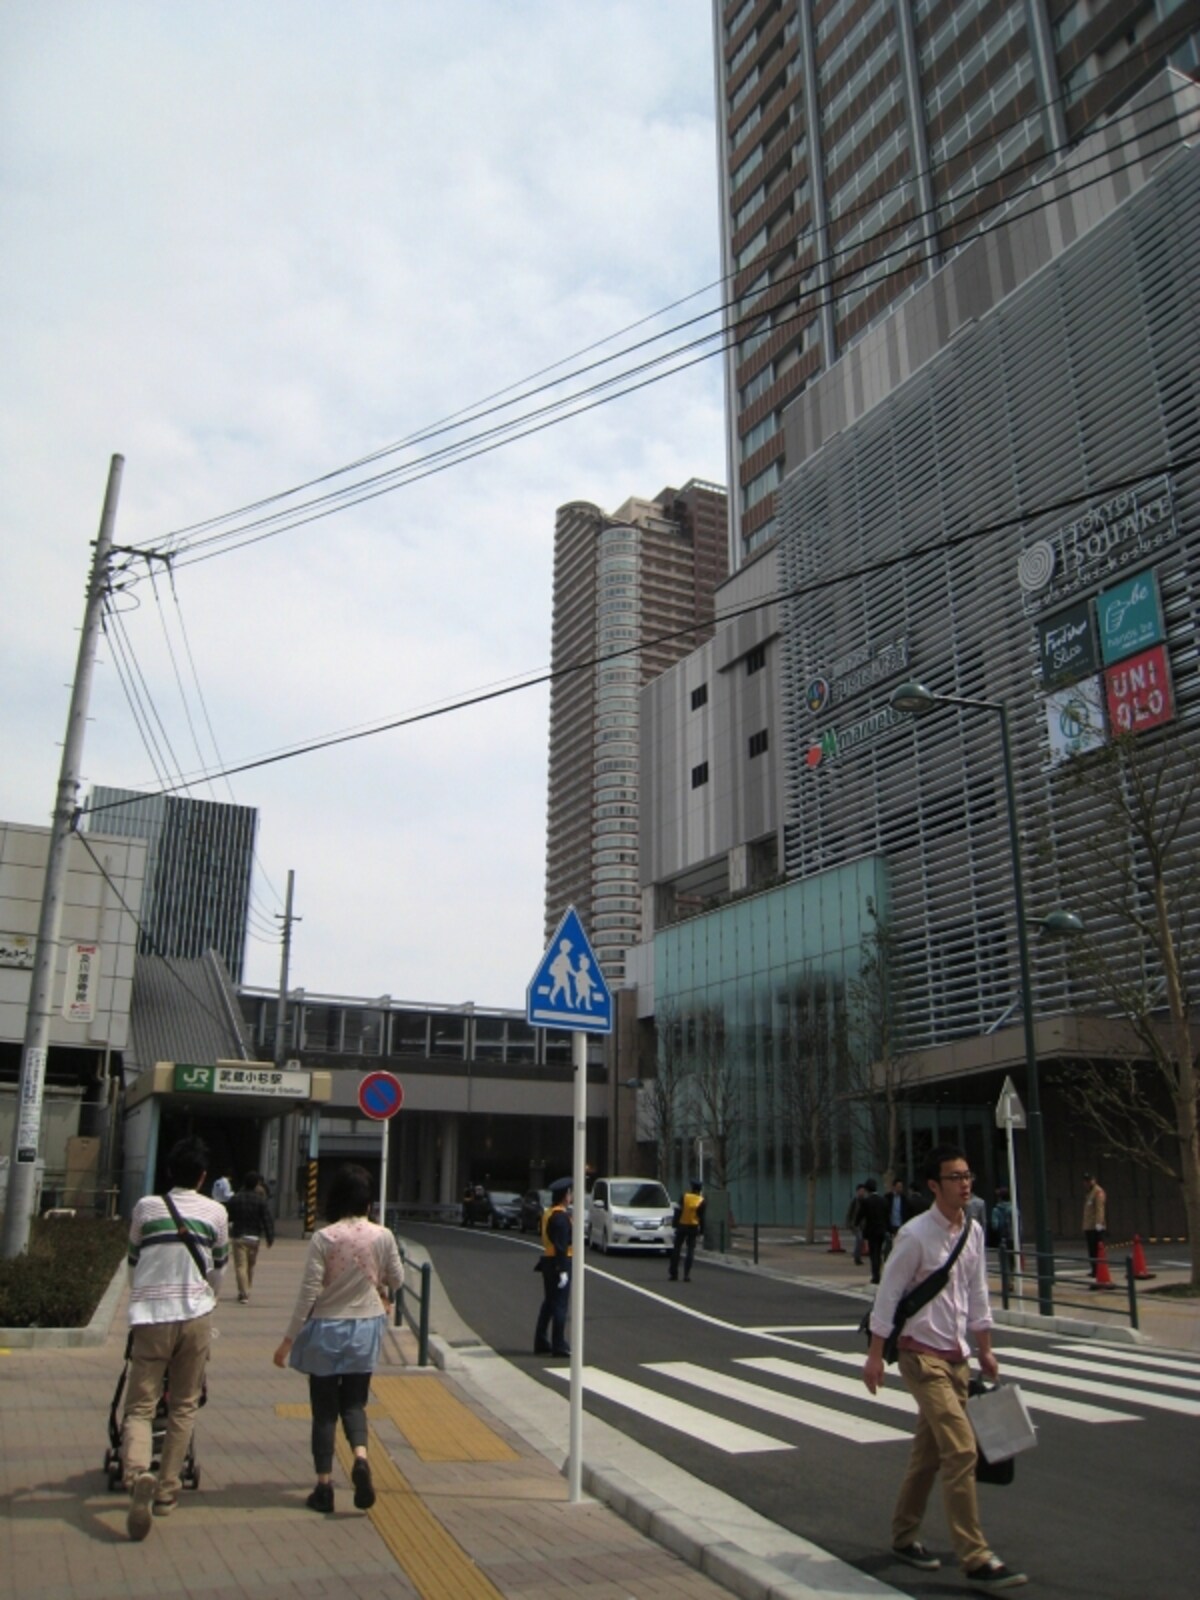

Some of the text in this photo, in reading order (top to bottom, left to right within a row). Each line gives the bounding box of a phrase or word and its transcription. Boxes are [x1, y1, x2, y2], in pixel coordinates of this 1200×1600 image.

[1074, 498, 1173, 566] SQUARE
[1113, 660, 1157, 697] UNI
[1117, 689, 1164, 730] QLO
[183, 1068, 211, 1083] JR
[220, 1070, 283, 1085] 武蔵小杉駅
